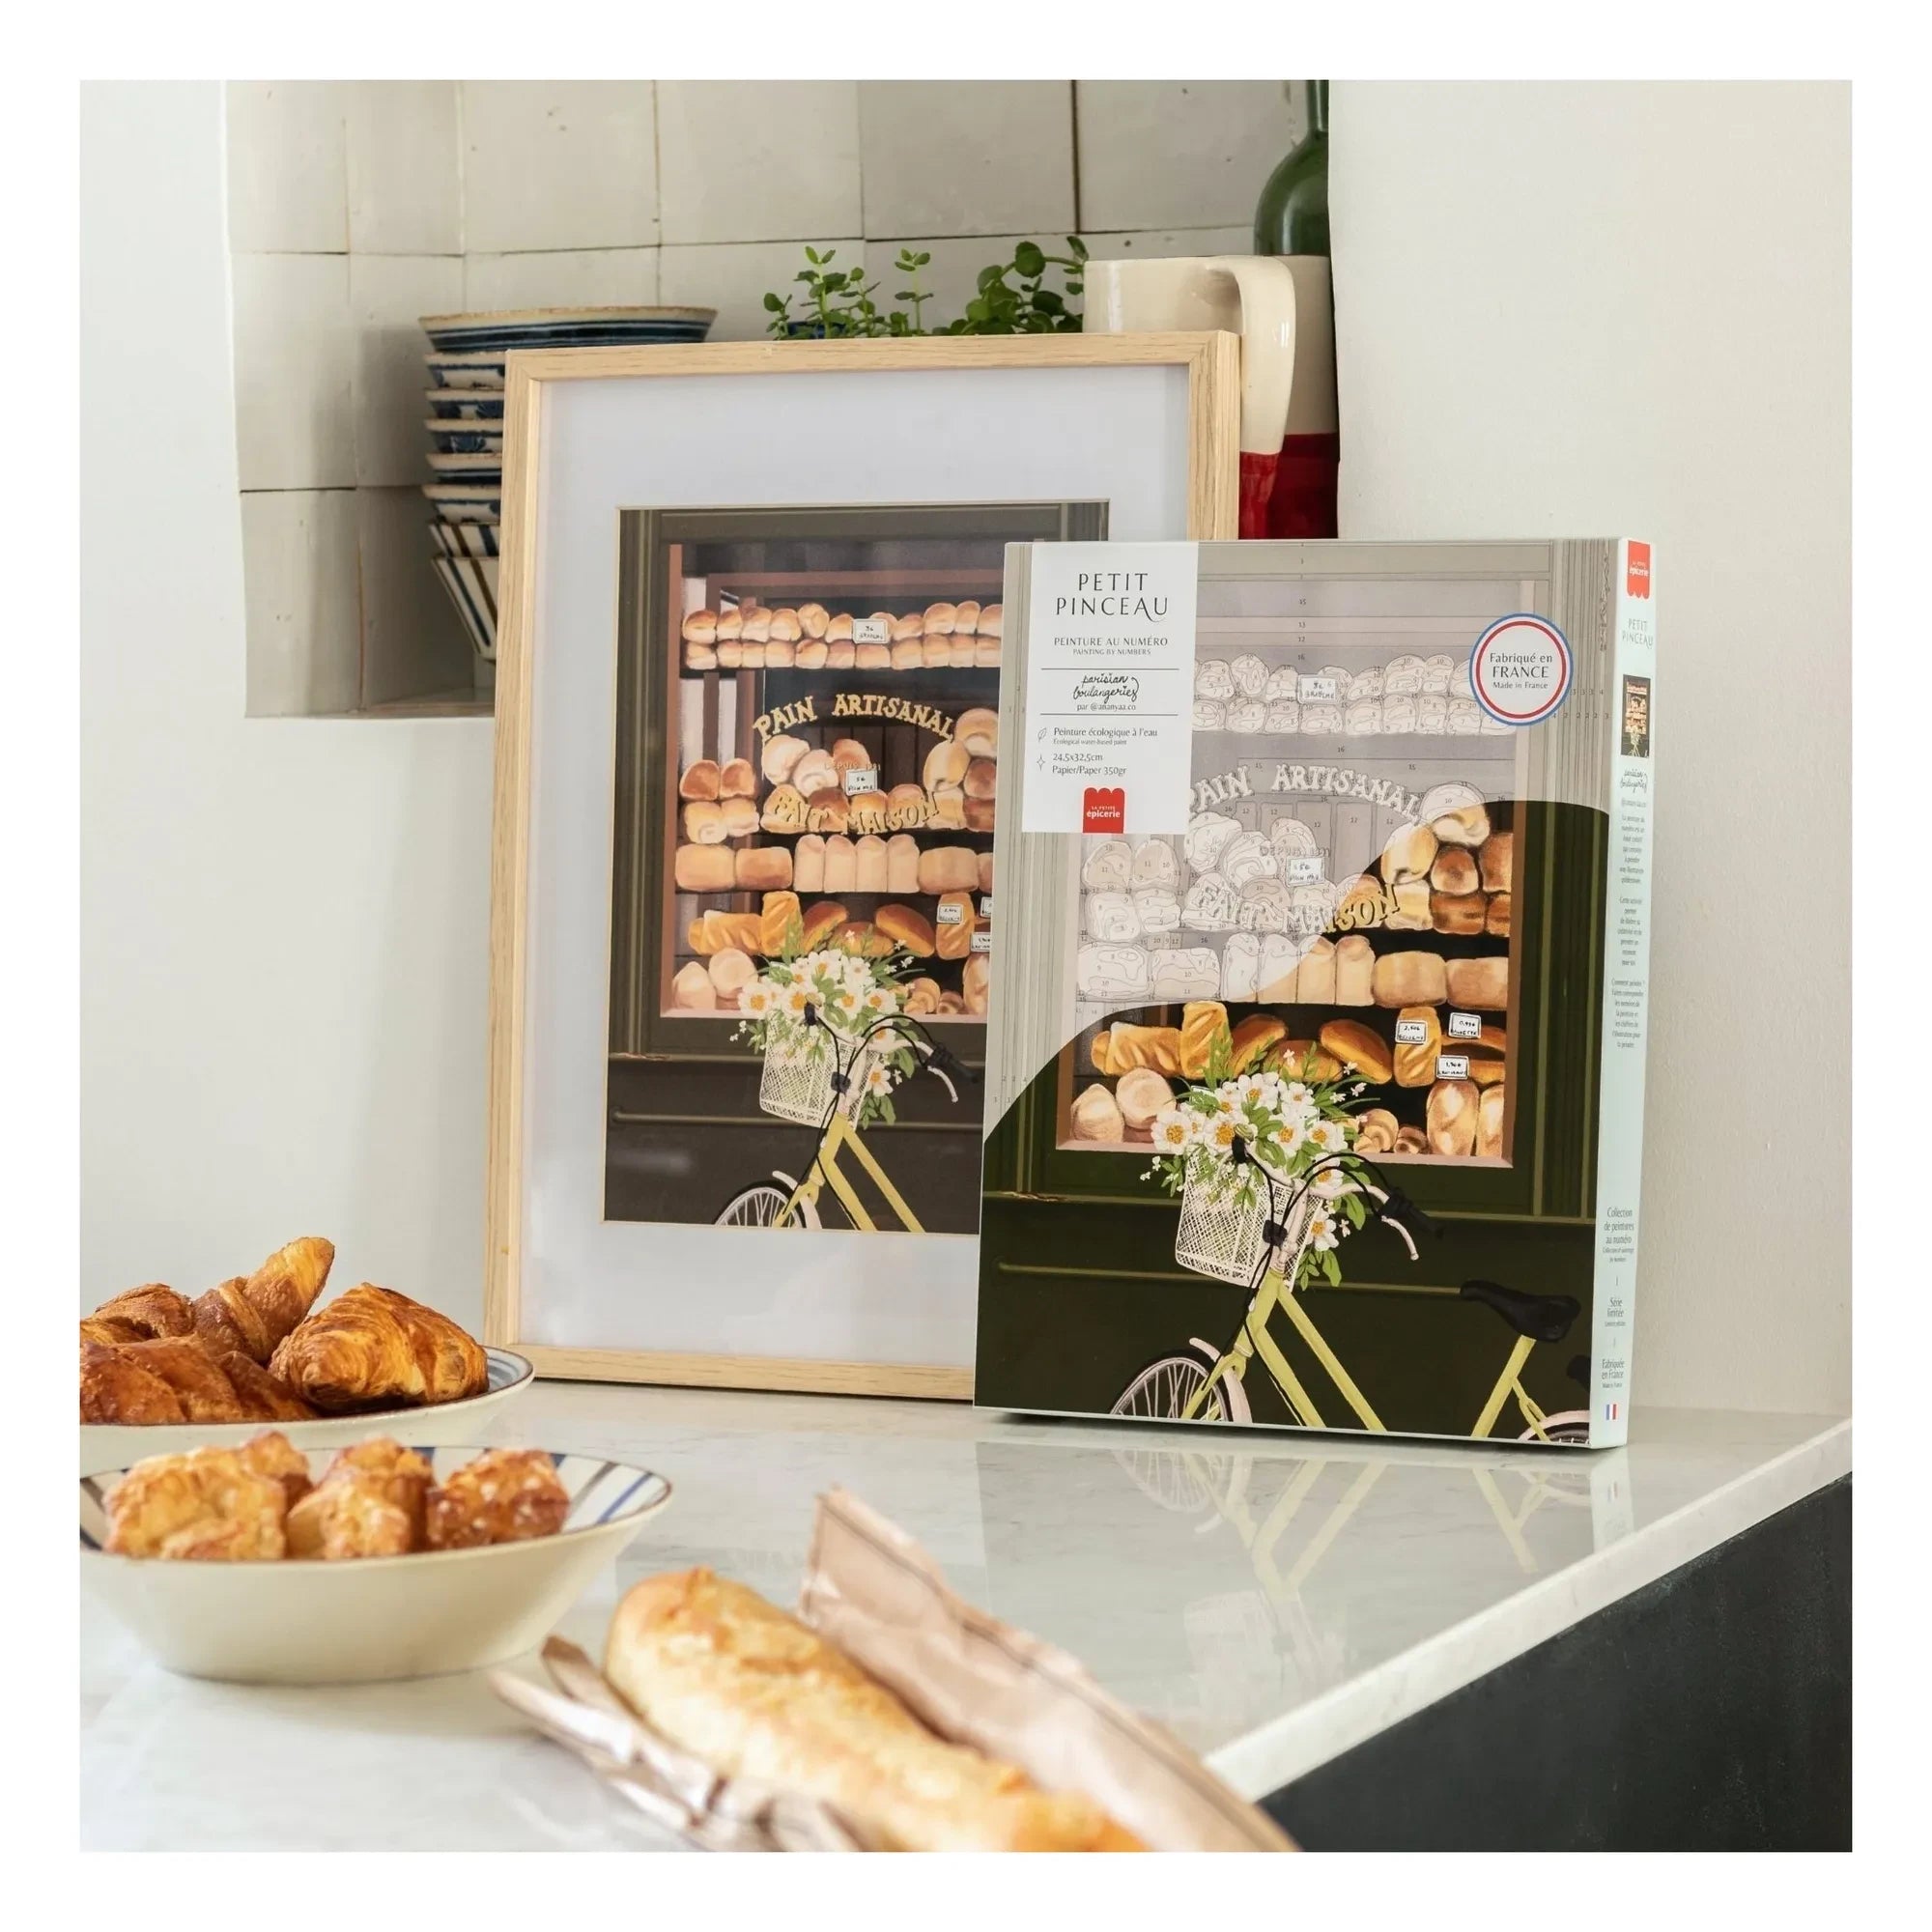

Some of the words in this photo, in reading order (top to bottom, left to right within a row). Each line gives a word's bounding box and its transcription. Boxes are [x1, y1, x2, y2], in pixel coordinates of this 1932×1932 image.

[1078, 573, 1149, 591] PETIT
[1057, 597, 1168, 622] PINCEAU
[1628, 617, 1647, 631] PETIT
[1054, 637, 1102, 646] PEINTURE
[1106, 637, 1120, 646] AU
[1123, 635, 1168, 646] NUMÉRO
[1622, 630, 1654, 649] PINCEAU
[1490, 652, 1536, 666] Fabriqué
[1539, 655, 1553, 664] en
[1492, 666, 1549, 678] FRANCE
[1081, 673, 1129, 688] parisian
[752, 696, 819, 742] PAIN
[831, 693, 955, 742] ARTISANAL
[1054, 727, 1087, 737] Peinture
[1088, 727, 1130, 738] écologique
[1131, 728, 1137, 737] à
[1139, 727, 1158, 737] l'eau
[1052, 765, 1102, 777] Papier/Paper
[1103, 766, 1127, 777] 350gr
[1271, 763, 1420, 827] ARTISANAL
[841, 791, 942, 836] MAISON
[1087, 810, 1121, 819] épicerie
[1282, 883, 1402, 934] MAISON
[1606, 1207, 1634, 1218] Collection
